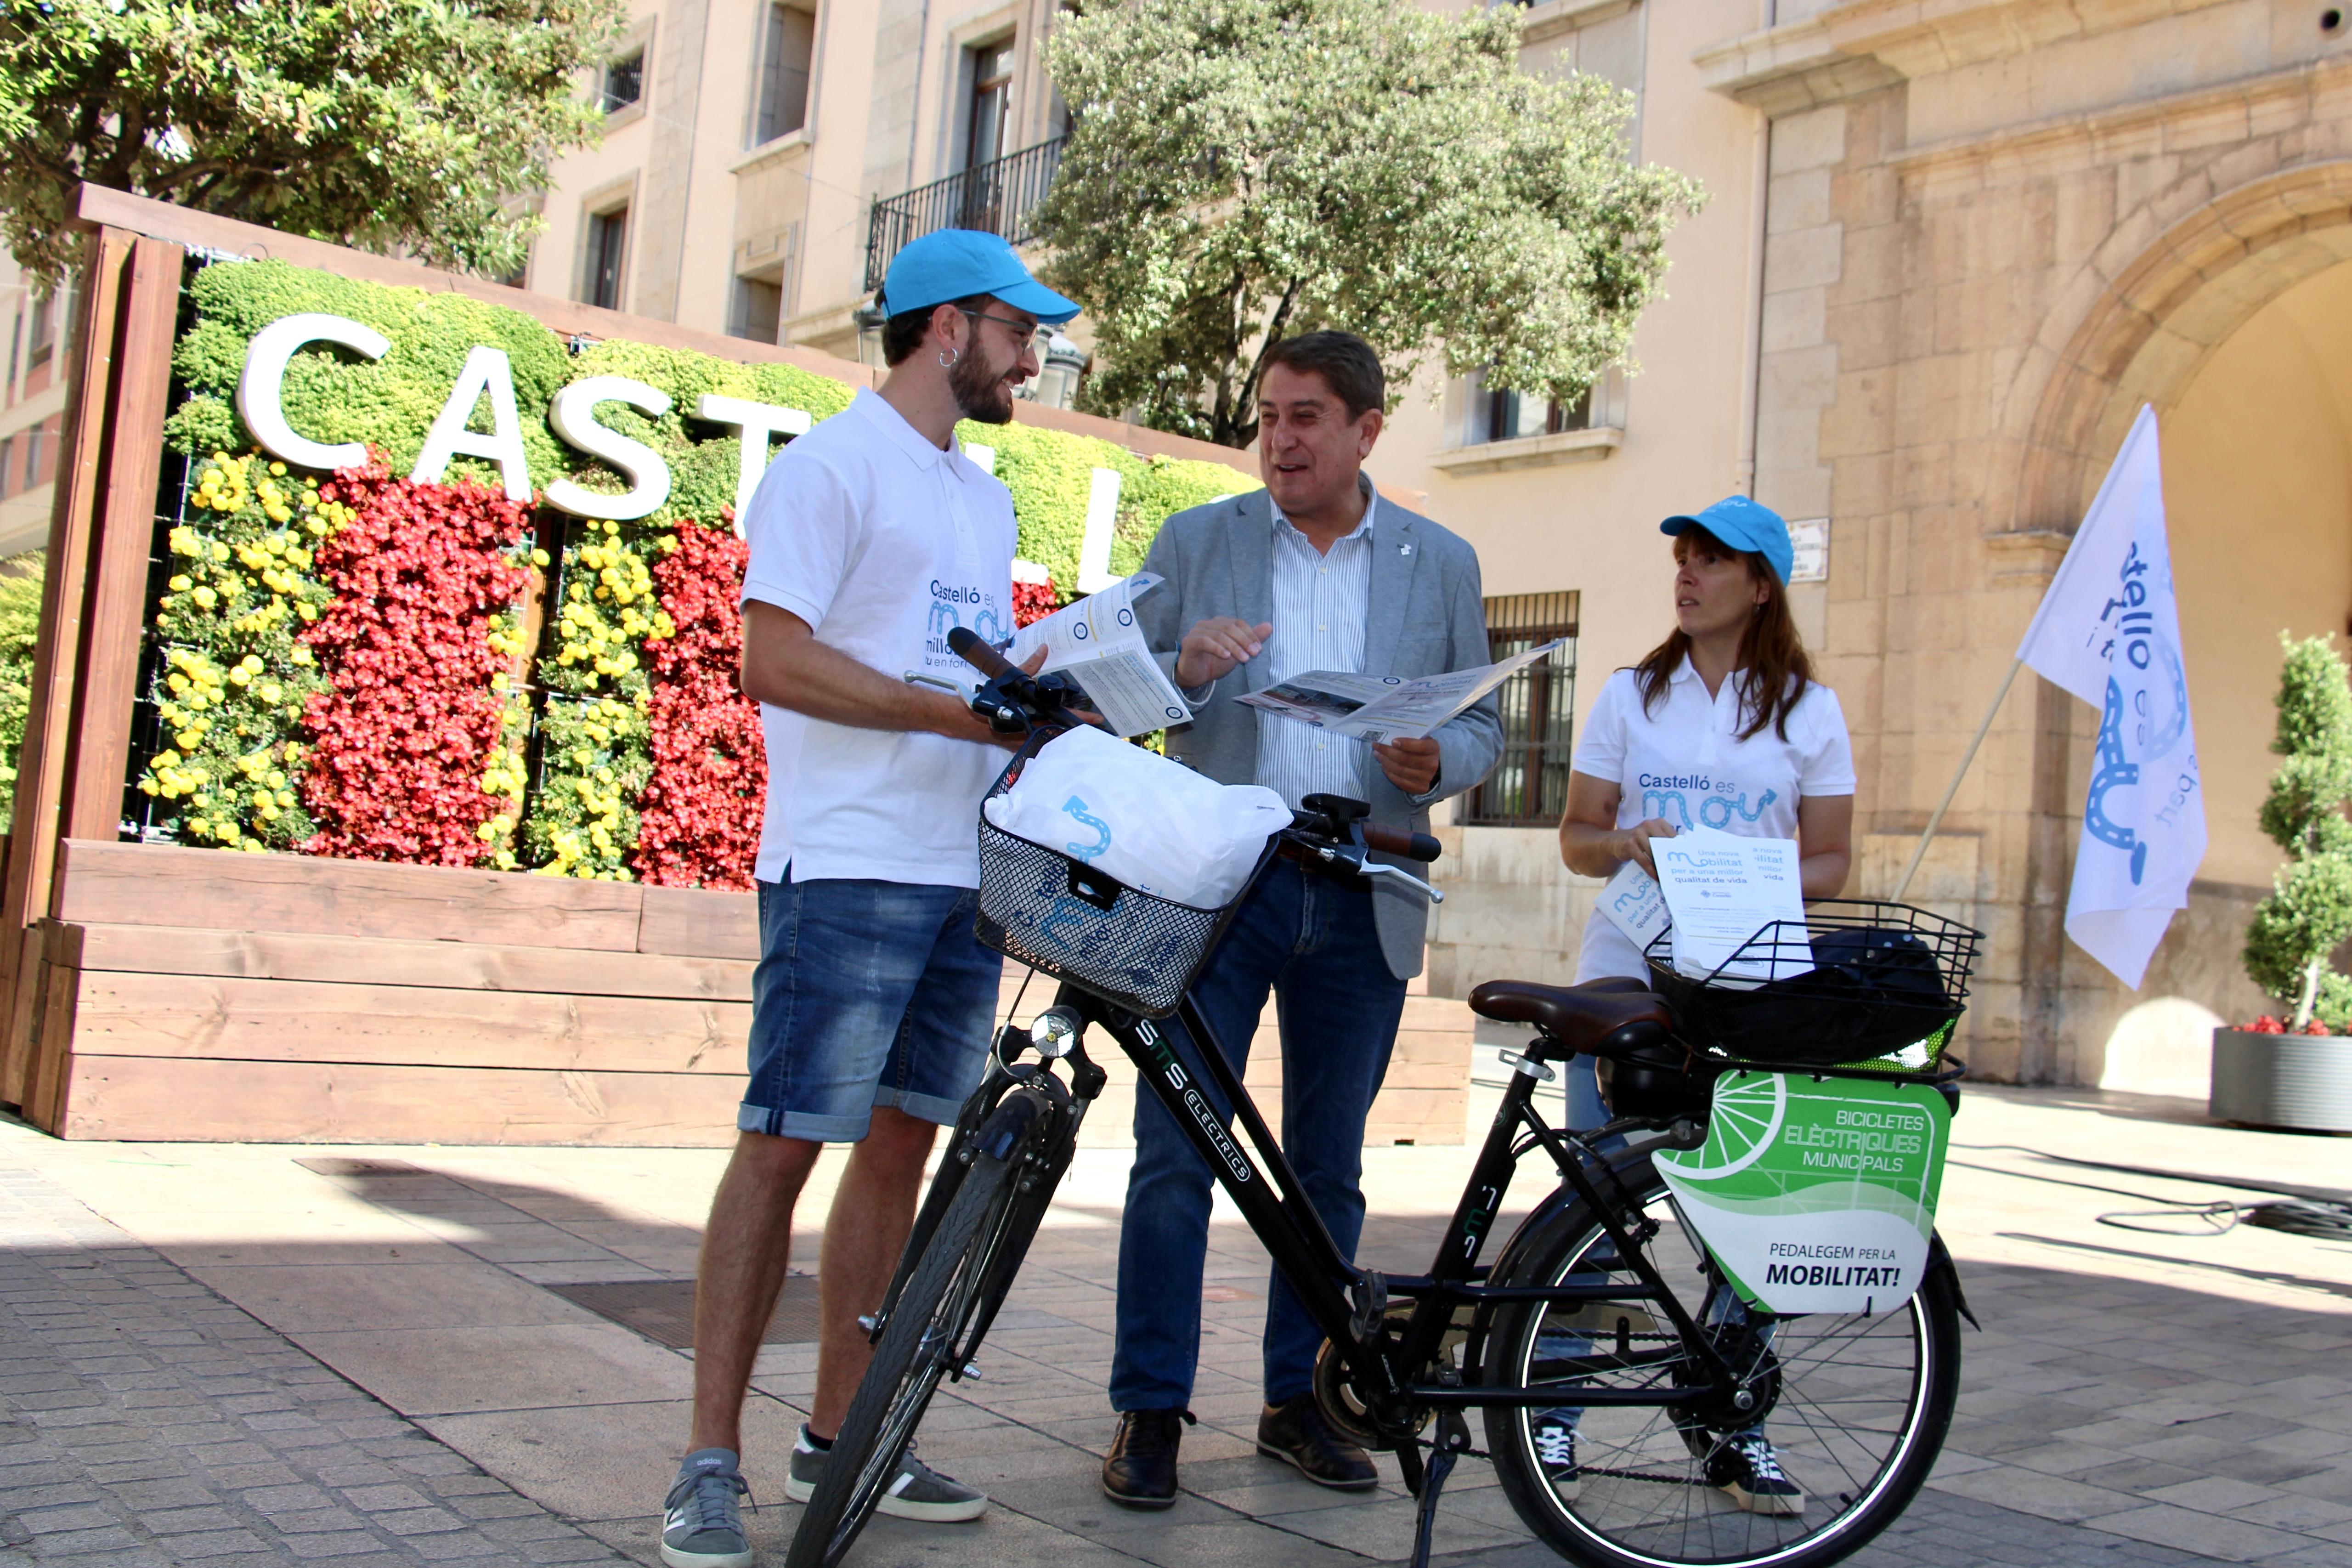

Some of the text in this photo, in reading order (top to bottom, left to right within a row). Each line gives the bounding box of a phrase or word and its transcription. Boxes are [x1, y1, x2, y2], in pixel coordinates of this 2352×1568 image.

[930, 579, 994, 608] Castelló es
[934, 659, 947, 668] en
[1639, 773, 1735, 794] Castelló es
[1629, 871, 1644, 885] Una
[1628, 910, 1639, 924] per
[1644, 892, 1657, 906] una
[1636, 903, 1661, 928] qualitat
[1836, 1110, 1924, 1131] BICICLETES
[1188, 1094, 1247, 1177] ELECTRICS
[1784, 1122, 1922, 1154] ELÈCTRIQUES
[1770, 1243, 1896, 1260] PEDALEGEM PER LA
[1766, 1264, 1901, 1287] MOBILITAT!
[697, 1457, 722, 1466] adidas
